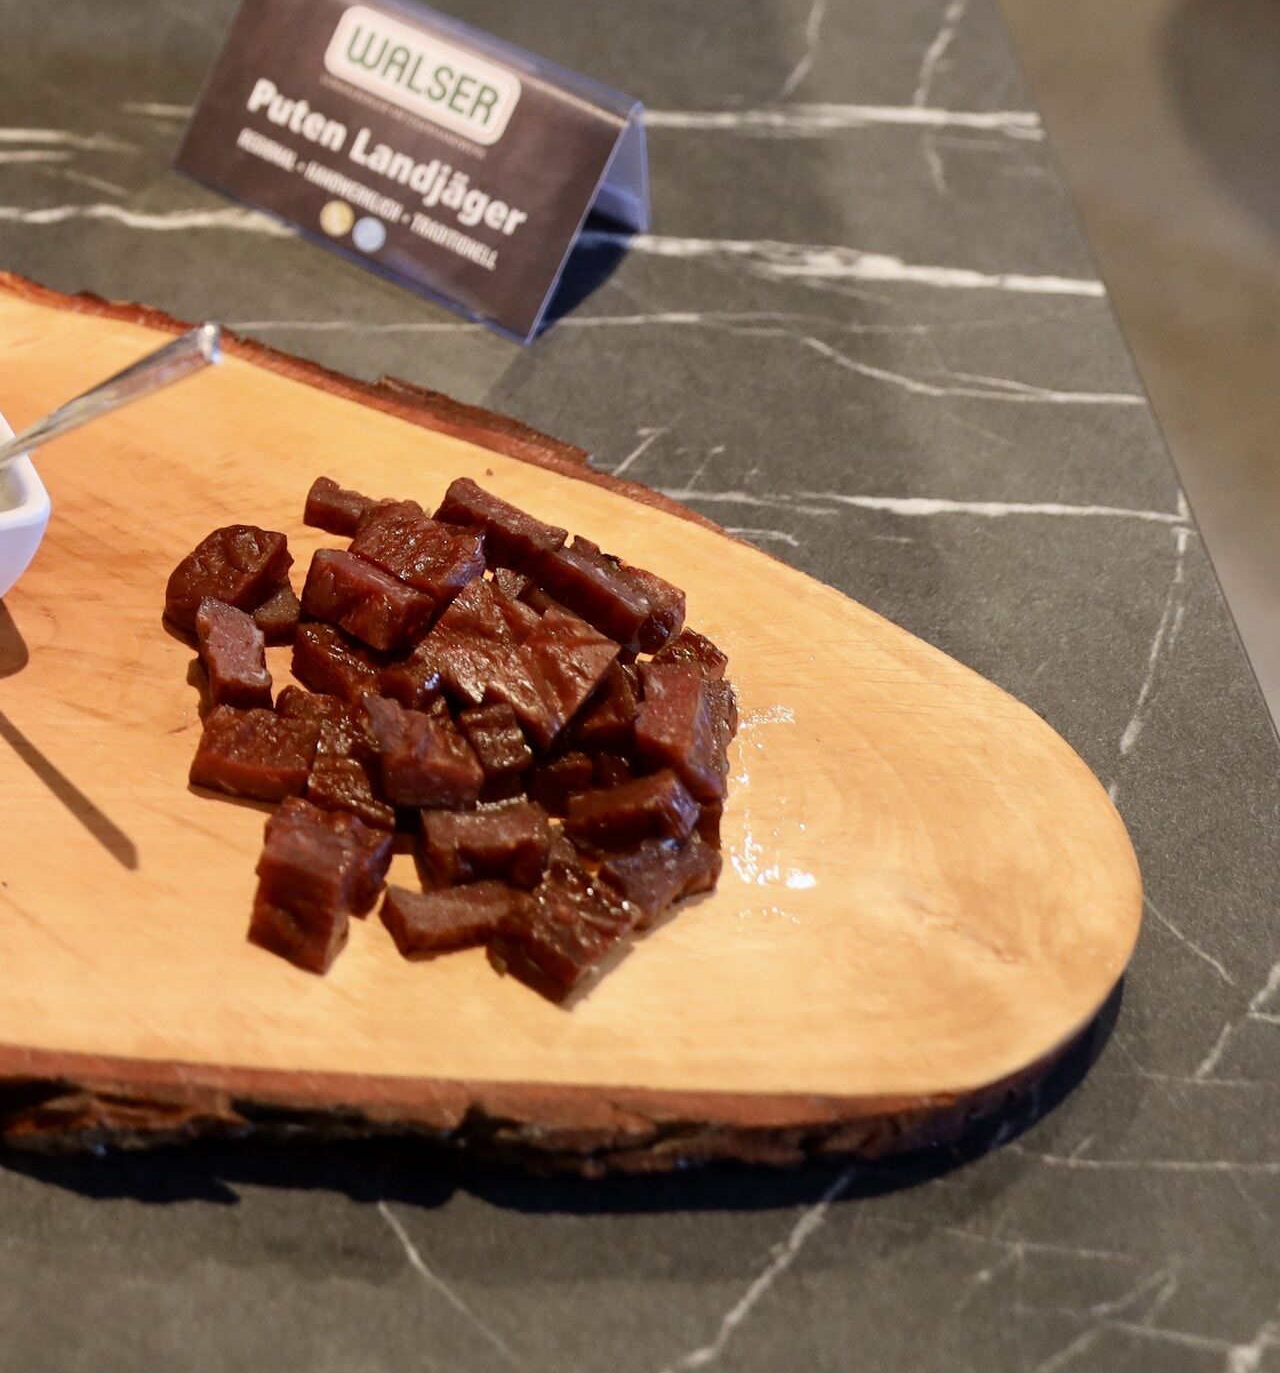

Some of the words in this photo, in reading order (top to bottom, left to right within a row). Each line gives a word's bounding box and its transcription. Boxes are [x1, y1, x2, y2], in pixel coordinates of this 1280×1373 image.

[346, 25, 500, 126] WALSER
[246, 77, 348, 153] Puten
[349, 128, 527, 236] Landjäger
